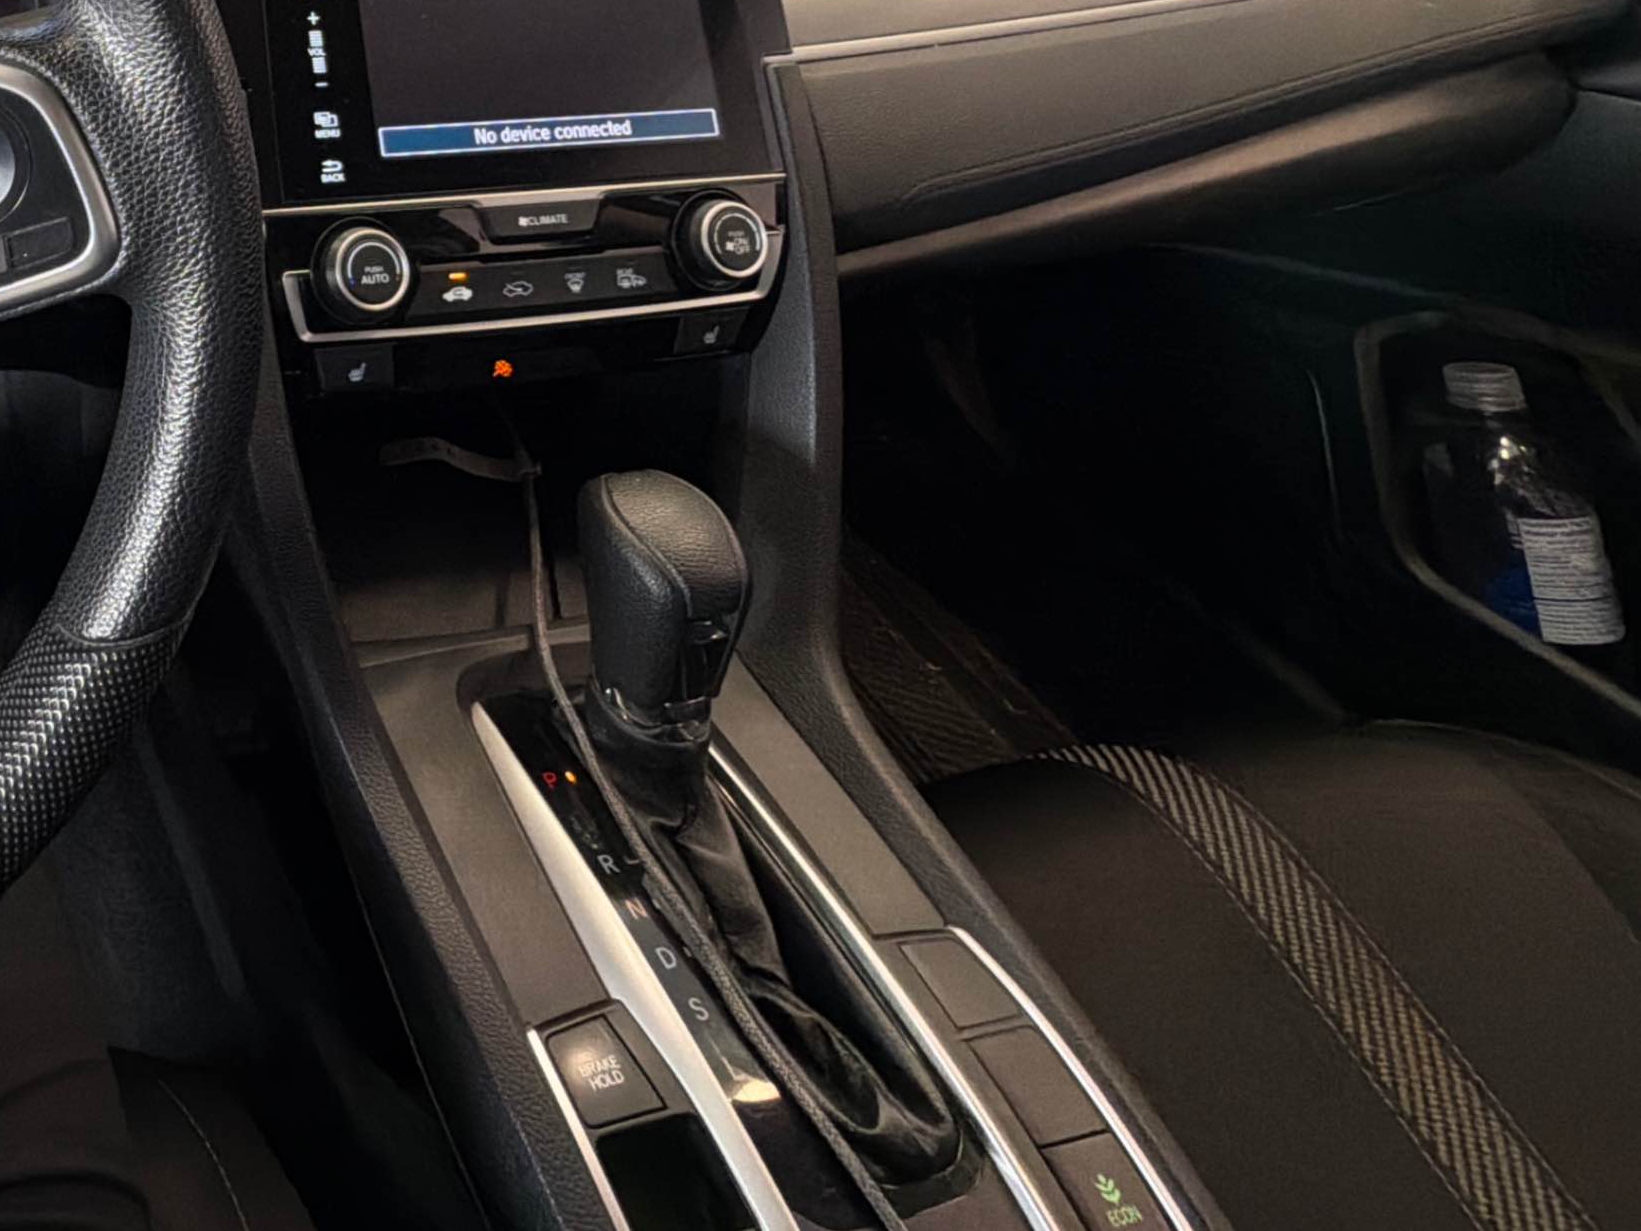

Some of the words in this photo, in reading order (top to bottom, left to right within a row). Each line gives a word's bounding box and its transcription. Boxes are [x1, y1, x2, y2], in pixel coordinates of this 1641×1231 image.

[307, 47, 326, 57] VOL
[473, 127, 497, 145] No
[501, 124, 551, 143] device
[554, 119, 633, 141] connected
[320, 172, 347, 184] BACK
[527, 213, 568, 227] CLIMATE
[360, 273, 391, 285] AUTO
[541, 771, 558, 788] P
[598, 854, 621, 875] R
[625, 897, 649, 920] N
[655, 946, 678, 970] D
[687, 997, 709, 1021] S
[587, 1070, 625, 1092] HOLD
[1108, 1205, 1143, 1228] ECON
